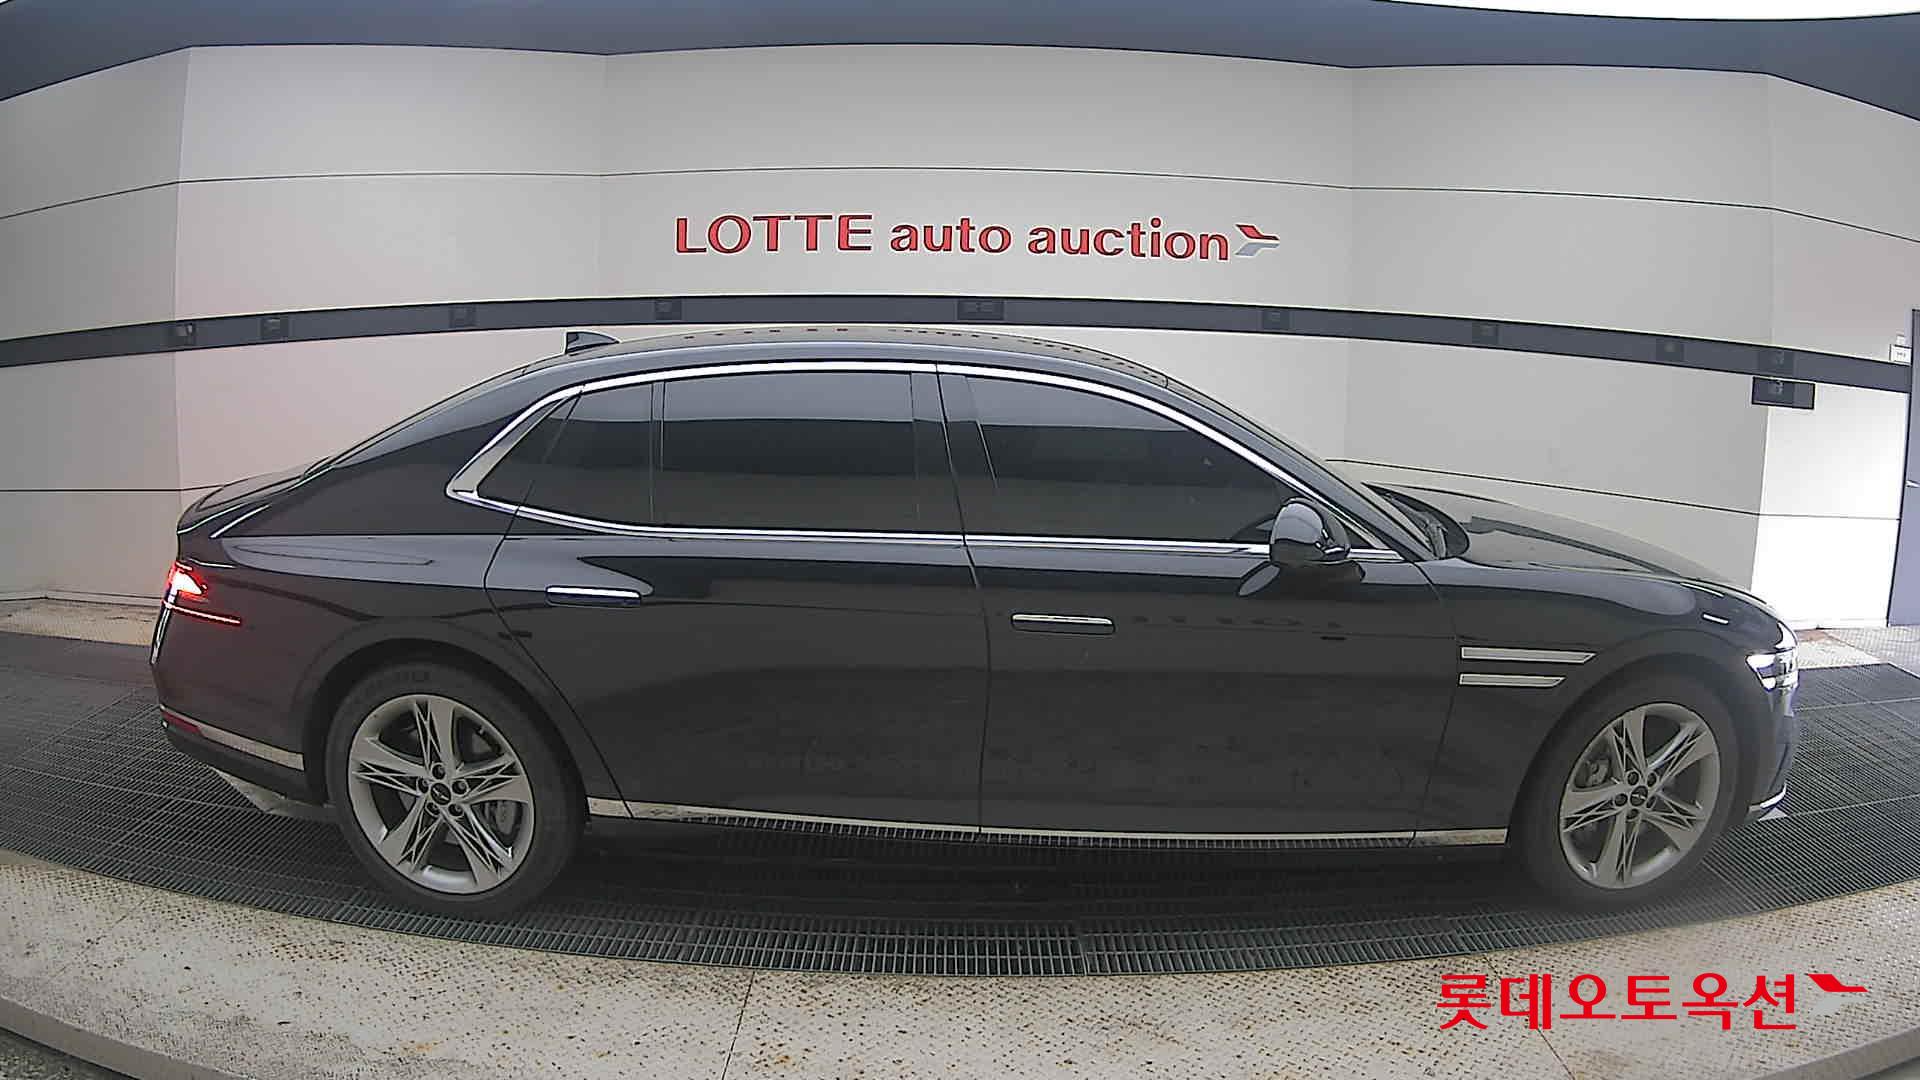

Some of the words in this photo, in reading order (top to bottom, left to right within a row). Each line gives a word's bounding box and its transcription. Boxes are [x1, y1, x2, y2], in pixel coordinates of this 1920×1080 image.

[675, 214, 873, 254] LOTTE
[890, 217, 1012, 254] auto
[1028, 217, 1230, 261] auction
